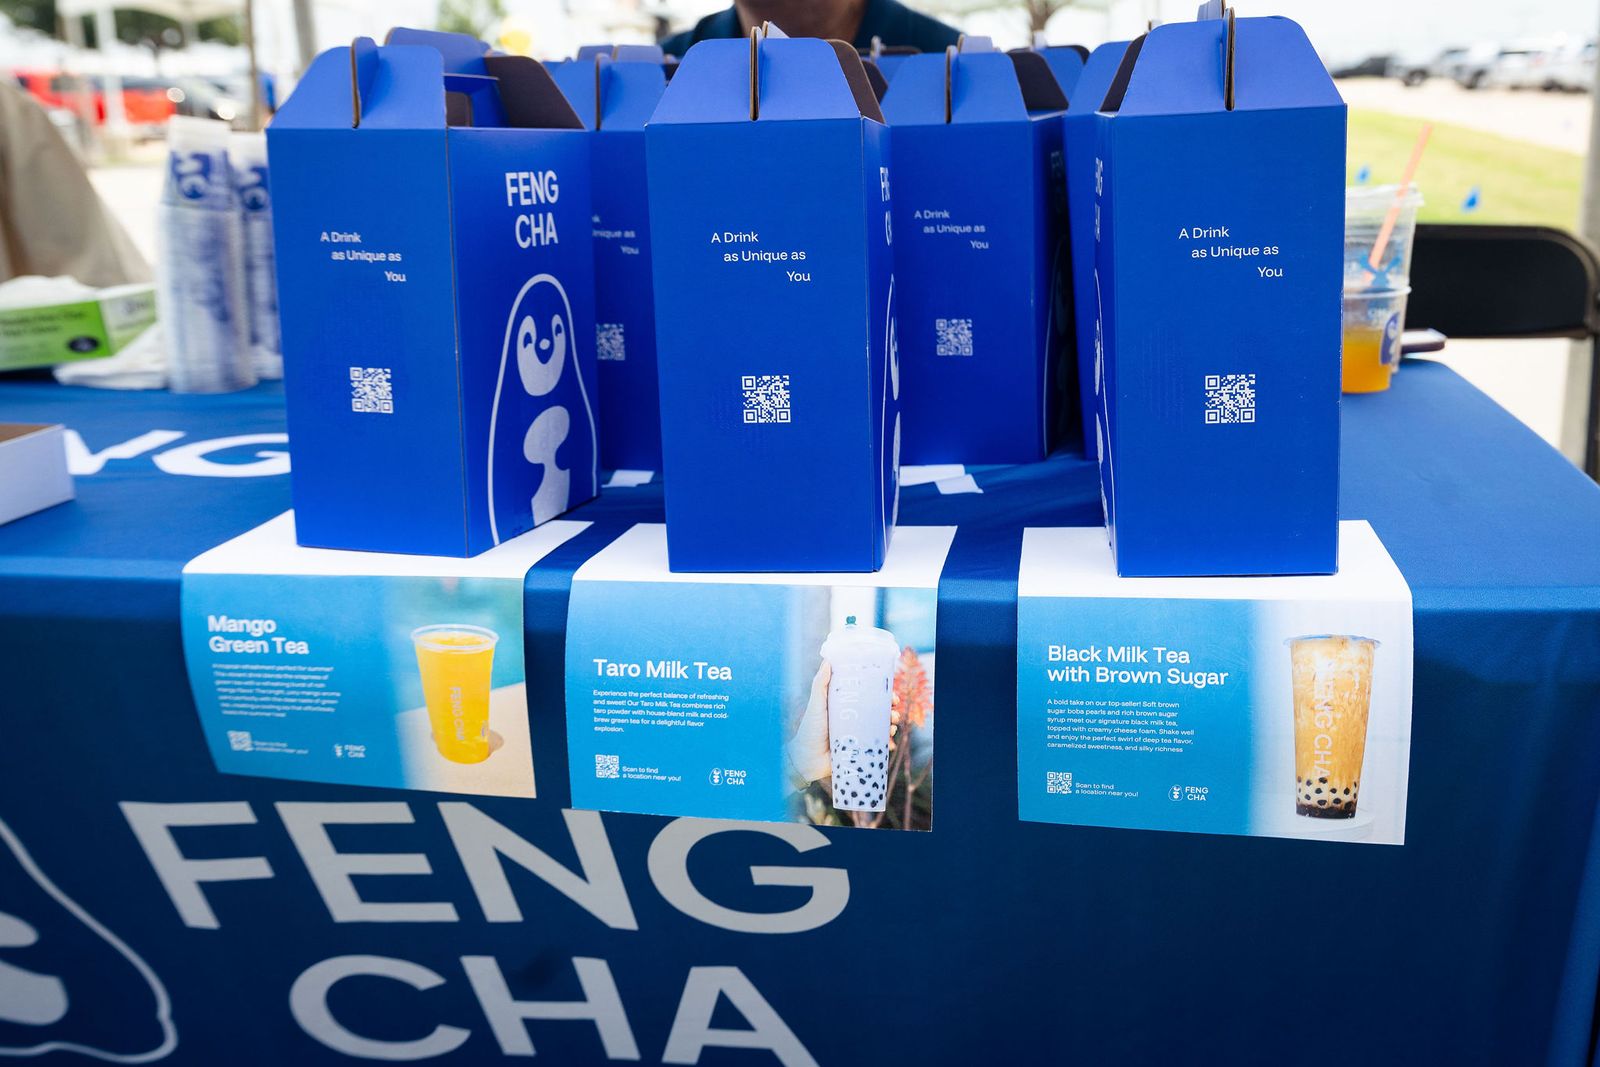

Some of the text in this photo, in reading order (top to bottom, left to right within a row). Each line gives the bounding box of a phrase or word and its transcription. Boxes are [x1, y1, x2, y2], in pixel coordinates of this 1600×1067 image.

[504, 170, 559, 207] FENG
[914, 209, 950, 220] A Drink
[514, 212, 559, 249] CHA
[923, 223, 986, 235] as Unique as
[1178, 226, 1230, 239] A Drink
[320, 231, 361, 243] A Drink
[711, 231, 759, 244] A Drink
[969, 240, 989, 249] You
[331, 250, 401, 264] as Unique as
[723, 249, 806, 265] as Unique as
[1191, 244, 1279, 260] as Unique as
[384, 271, 407, 282] You
[786, 270, 811, 282] You
[1257, 266, 1283, 278] You
[207, 615, 277, 637] Mango
[208, 635, 310, 655] Green Tea
[1048, 645, 1191, 664] Black Milk Tea
[592, 658, 733, 680] Taro Milk Tea
[1047, 666, 1229, 688] with Brown Sugar
[592, 689, 627, 697] Experience
[696, 693, 730, 701] refreshing
[1098, 718, 1130, 726] signature
[1087, 727, 1113, 735] creamy
[1060, 734, 1080, 742] enjoy
[1092, 735, 1117, 743] perfect
[1138, 745, 1154, 753] silky
[1313, 735, 1332, 779] CHA
[724, 769, 747, 778] FENG
[726, 777, 745, 785] CHA
[1184, 785, 1209, 794] FENG
[118, 801, 851, 933] FENG
[289, 954, 820, 1067] CHA
